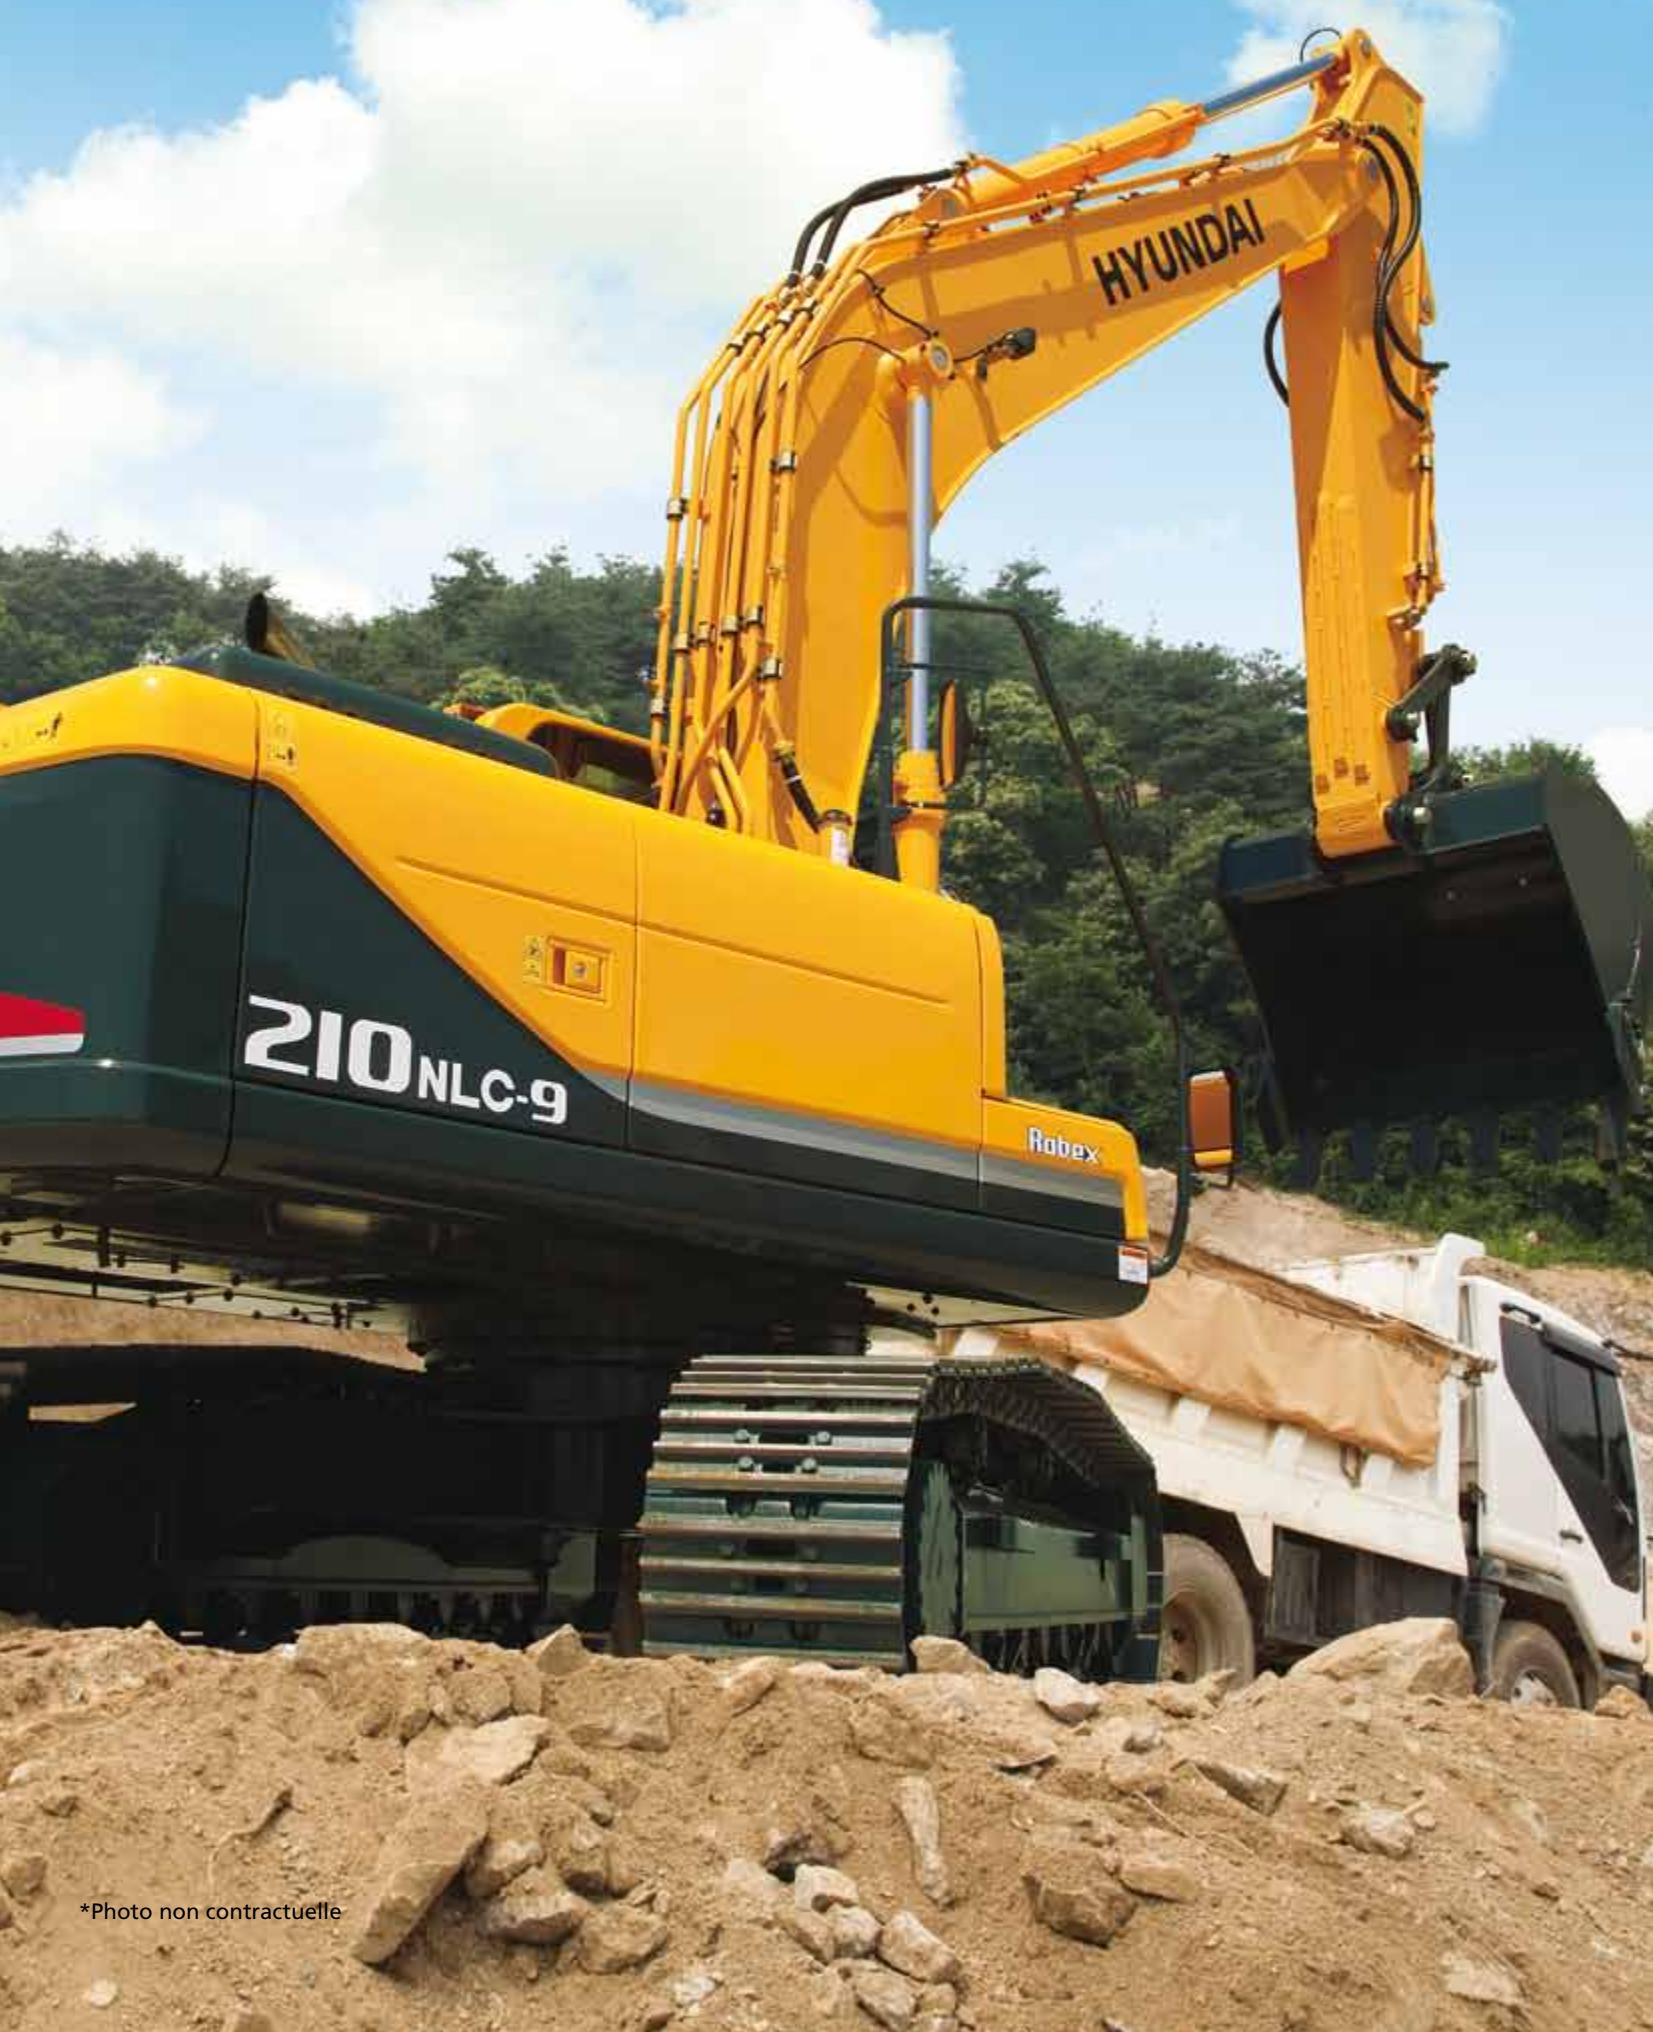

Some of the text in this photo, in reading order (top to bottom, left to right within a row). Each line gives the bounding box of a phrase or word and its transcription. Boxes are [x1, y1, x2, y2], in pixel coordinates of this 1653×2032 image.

[1093, 199, 1264, 305] HYUNDAI
[244, 995, 568, 1125] 210 NLC-9
[1029, 1127, 1100, 1164] Robex
